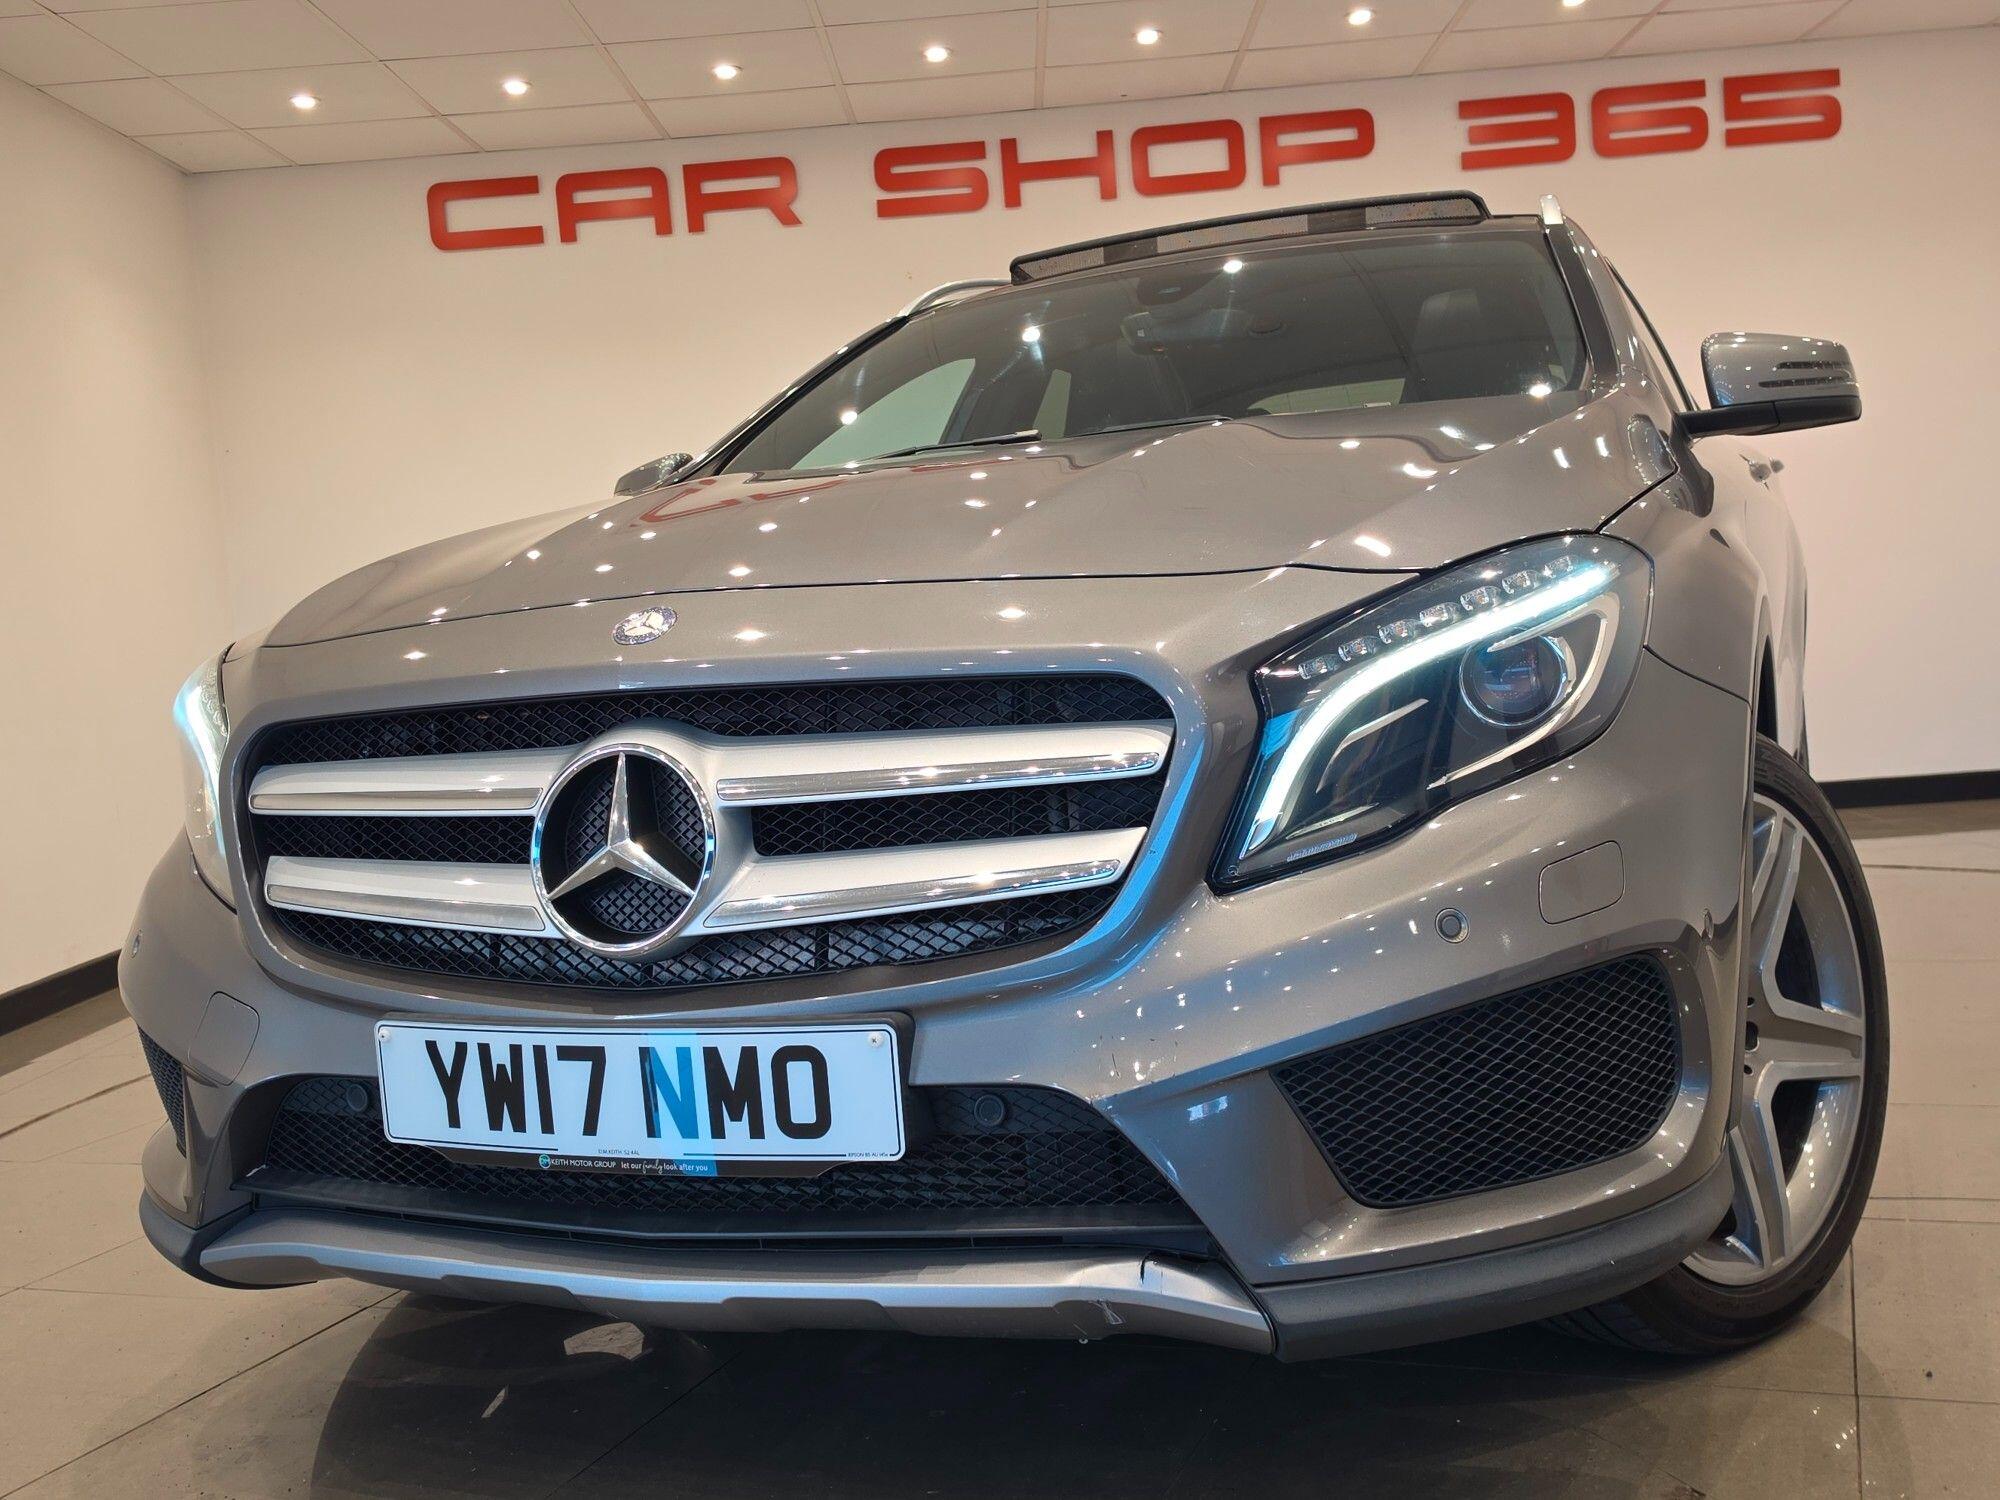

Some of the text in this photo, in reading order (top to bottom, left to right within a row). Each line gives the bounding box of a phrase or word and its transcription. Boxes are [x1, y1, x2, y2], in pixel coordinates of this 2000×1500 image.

[427, 69, 1842, 251] CAR SHOP 365
[424, 1039, 832, 1140] YW17 NMO
[551, 1159, 569, 1167] KEITH
[570, 1160, 593, 1168] MOTOR
[593, 1160, 617, 1169] GROUP
[621, 1161, 630, 1170] let
[663, 1163, 678, 1172] look
[679, 1163, 695, 1172] after
[696, 1164, 709, 1172] you
